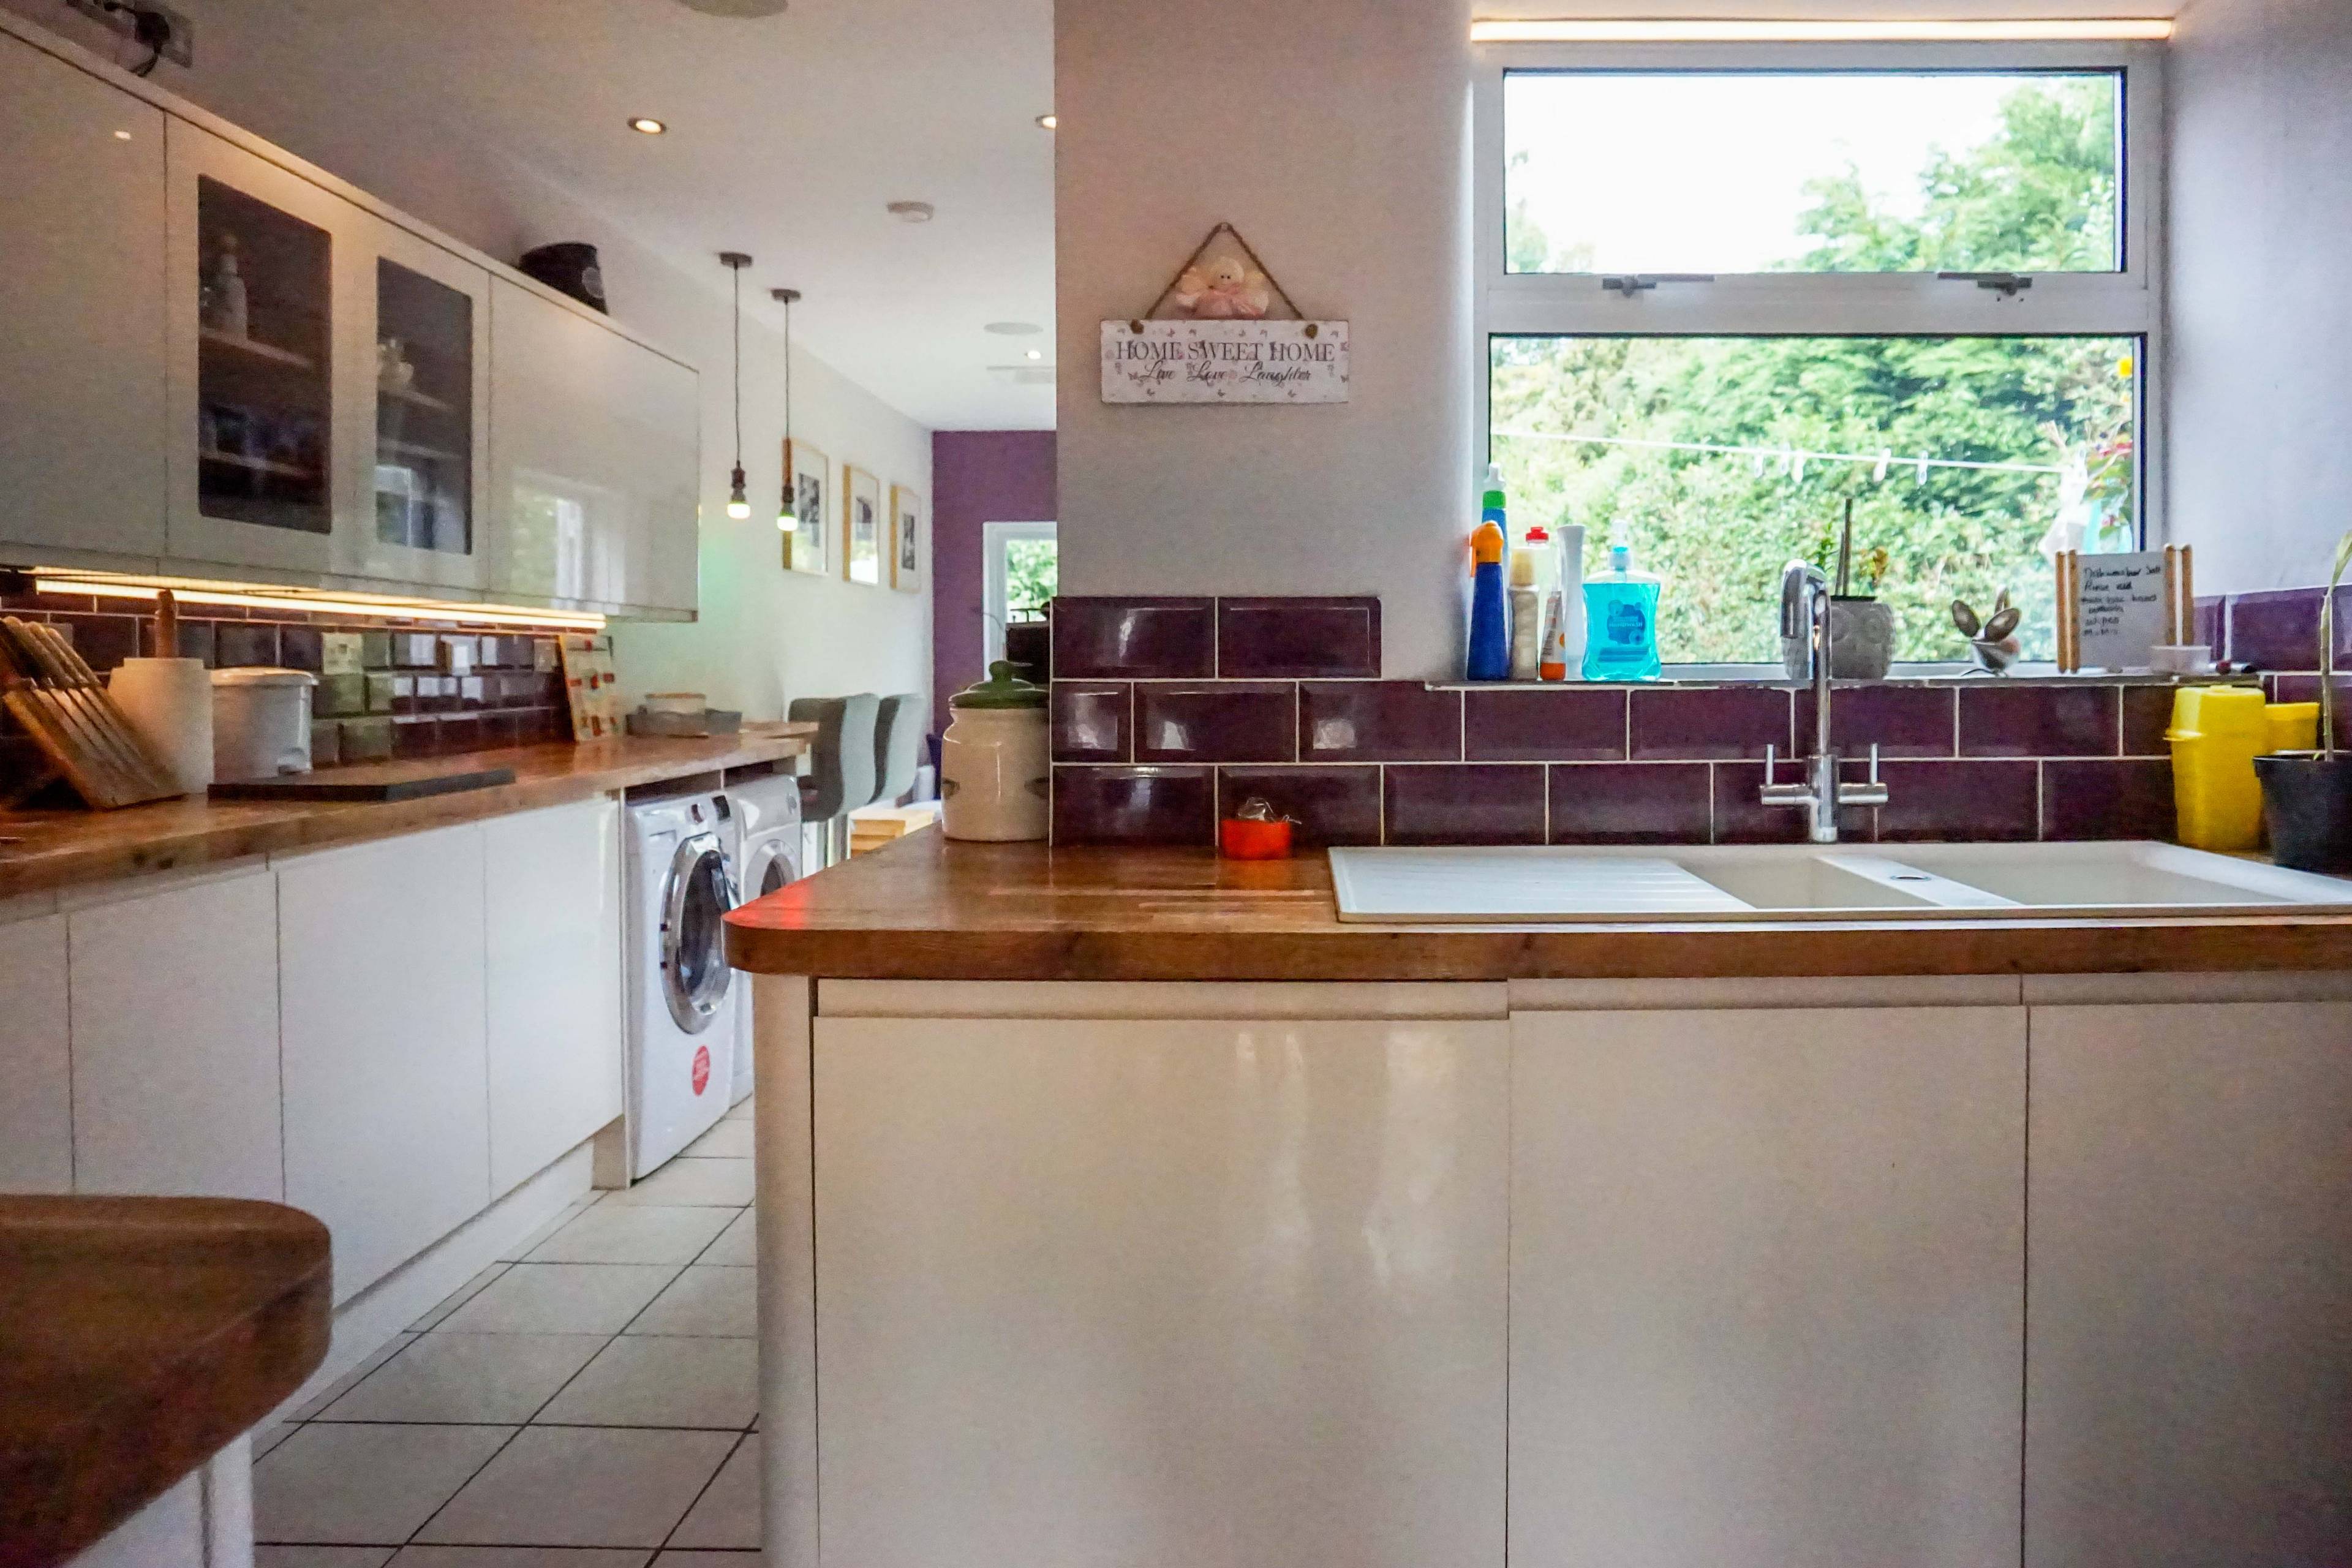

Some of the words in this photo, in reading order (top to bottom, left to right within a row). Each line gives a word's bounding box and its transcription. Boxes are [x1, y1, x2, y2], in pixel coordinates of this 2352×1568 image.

[1115, 341, 1181, 360] HOME
[1188, 341, 1264, 361] SWEET
[1270, 341, 1336, 361] HOME
[1139, 360, 1175, 380] Live
[1186, 360, 1227, 383] Love
